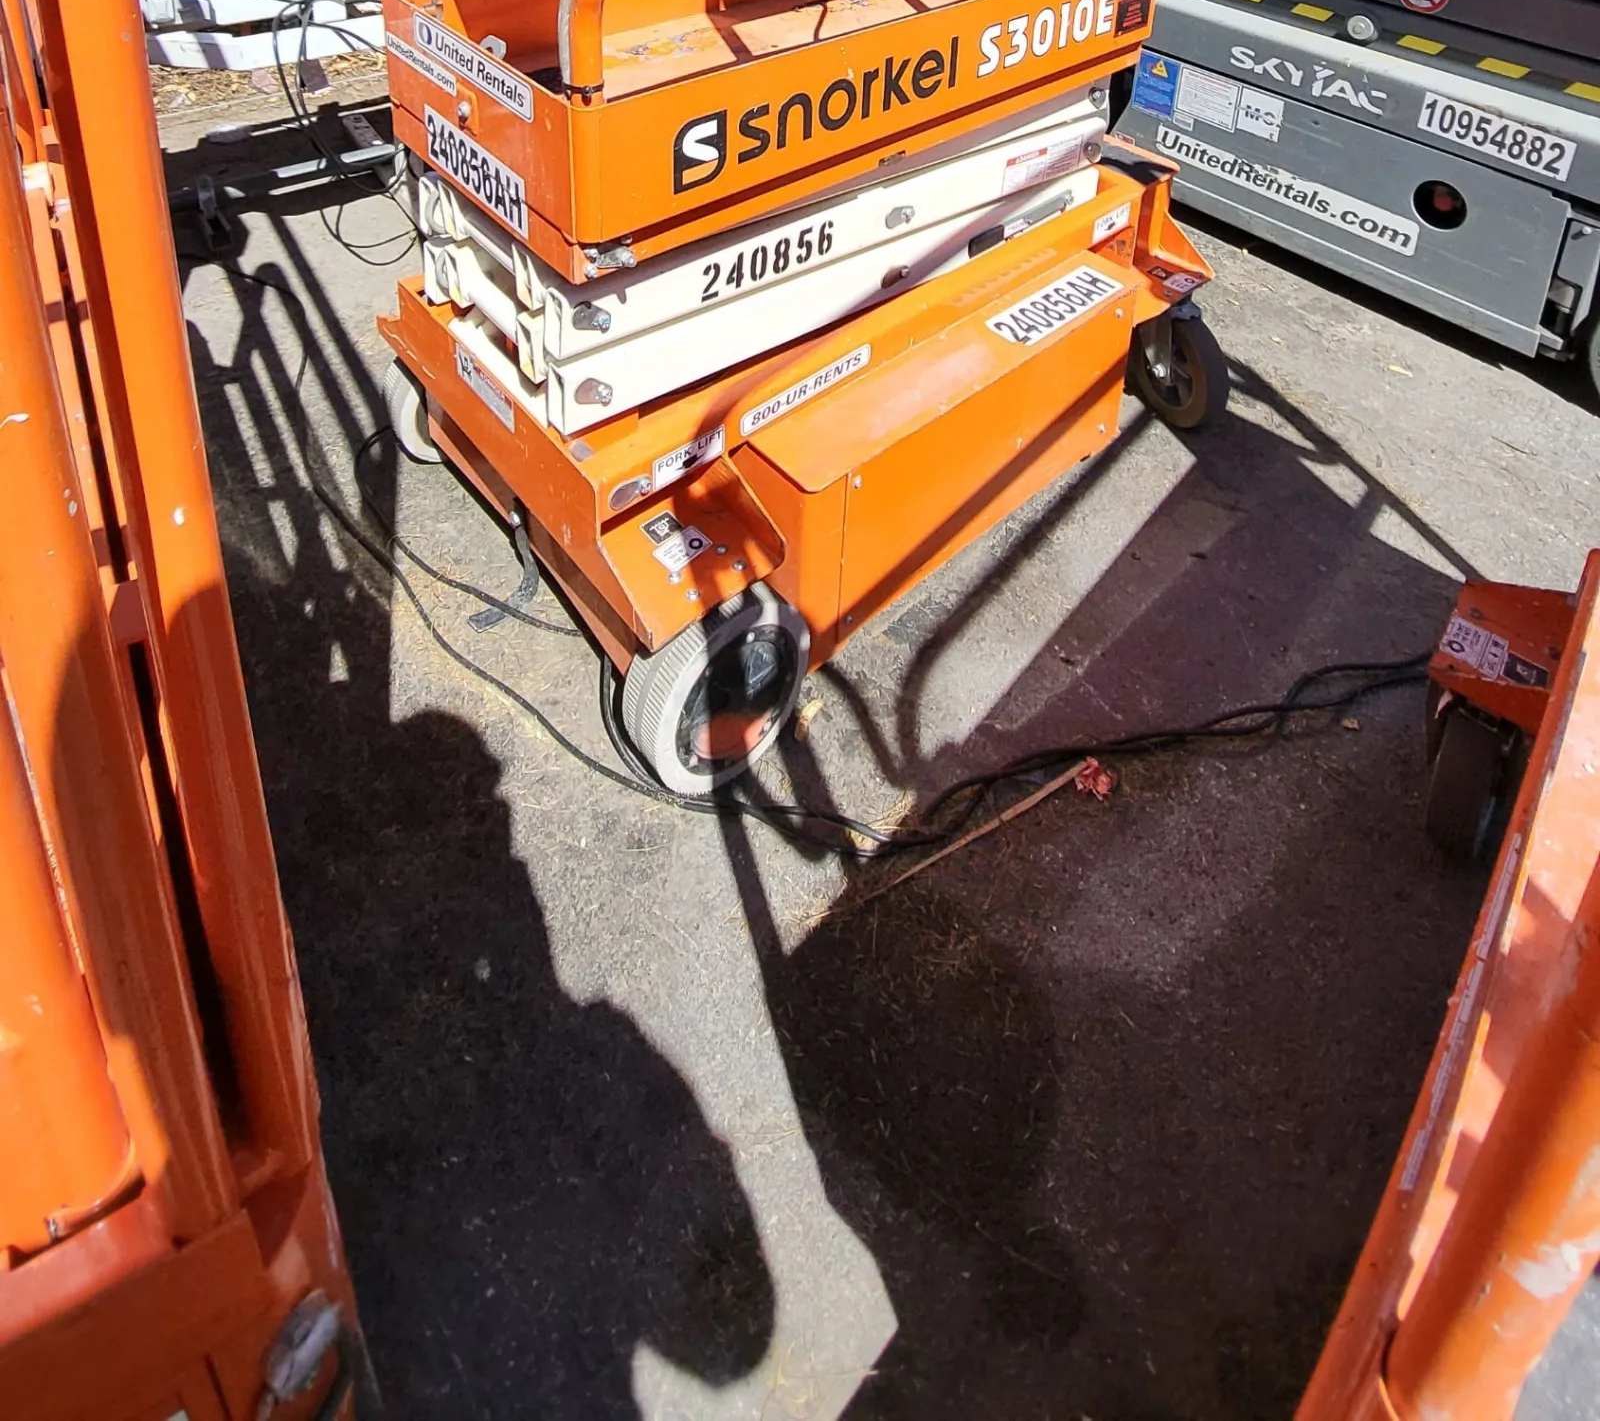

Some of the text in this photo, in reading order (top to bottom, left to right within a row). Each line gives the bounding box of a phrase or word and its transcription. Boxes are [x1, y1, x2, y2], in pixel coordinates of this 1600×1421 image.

[387, 35, 456, 92] UnitedRentals.com
[434, 32, 525, 109] United Rentals
[737, 36, 960, 165] snorkel
[427, 114, 523, 230] 240856AH
[1425, 98, 1566, 175] 10954882
[1160, 130, 1413, 248] UnitedRentals.com
[701, 220, 834, 303] 240856
[994, 271, 1116, 345] 240856AH
[751, 352, 862, 427] 800-UR-RENTS
[657, 429, 723, 473] FORK LIFT
